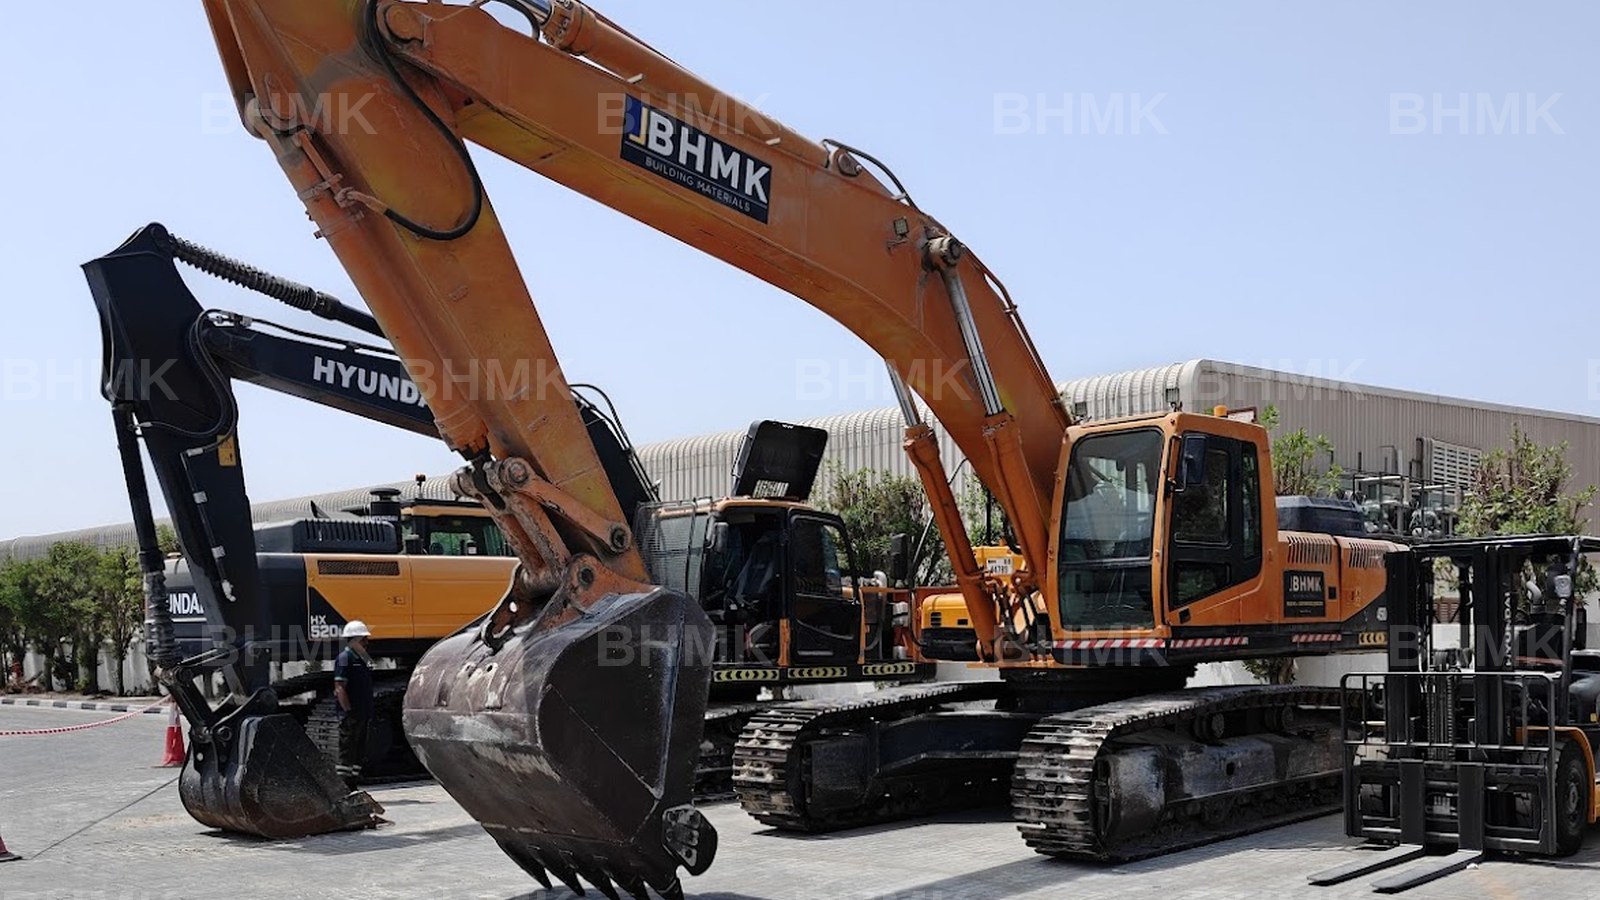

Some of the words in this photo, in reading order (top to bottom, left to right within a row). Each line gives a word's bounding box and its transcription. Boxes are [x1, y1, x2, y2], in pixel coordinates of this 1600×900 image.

[645, 156, 694, 186] BUILDING
[697, 181, 751, 212] MATERIALS
[313, 356, 428, 408] HYUND
[310, 614, 327, 625] HX
[1504, 592, 1512, 666] HYUNDAI
